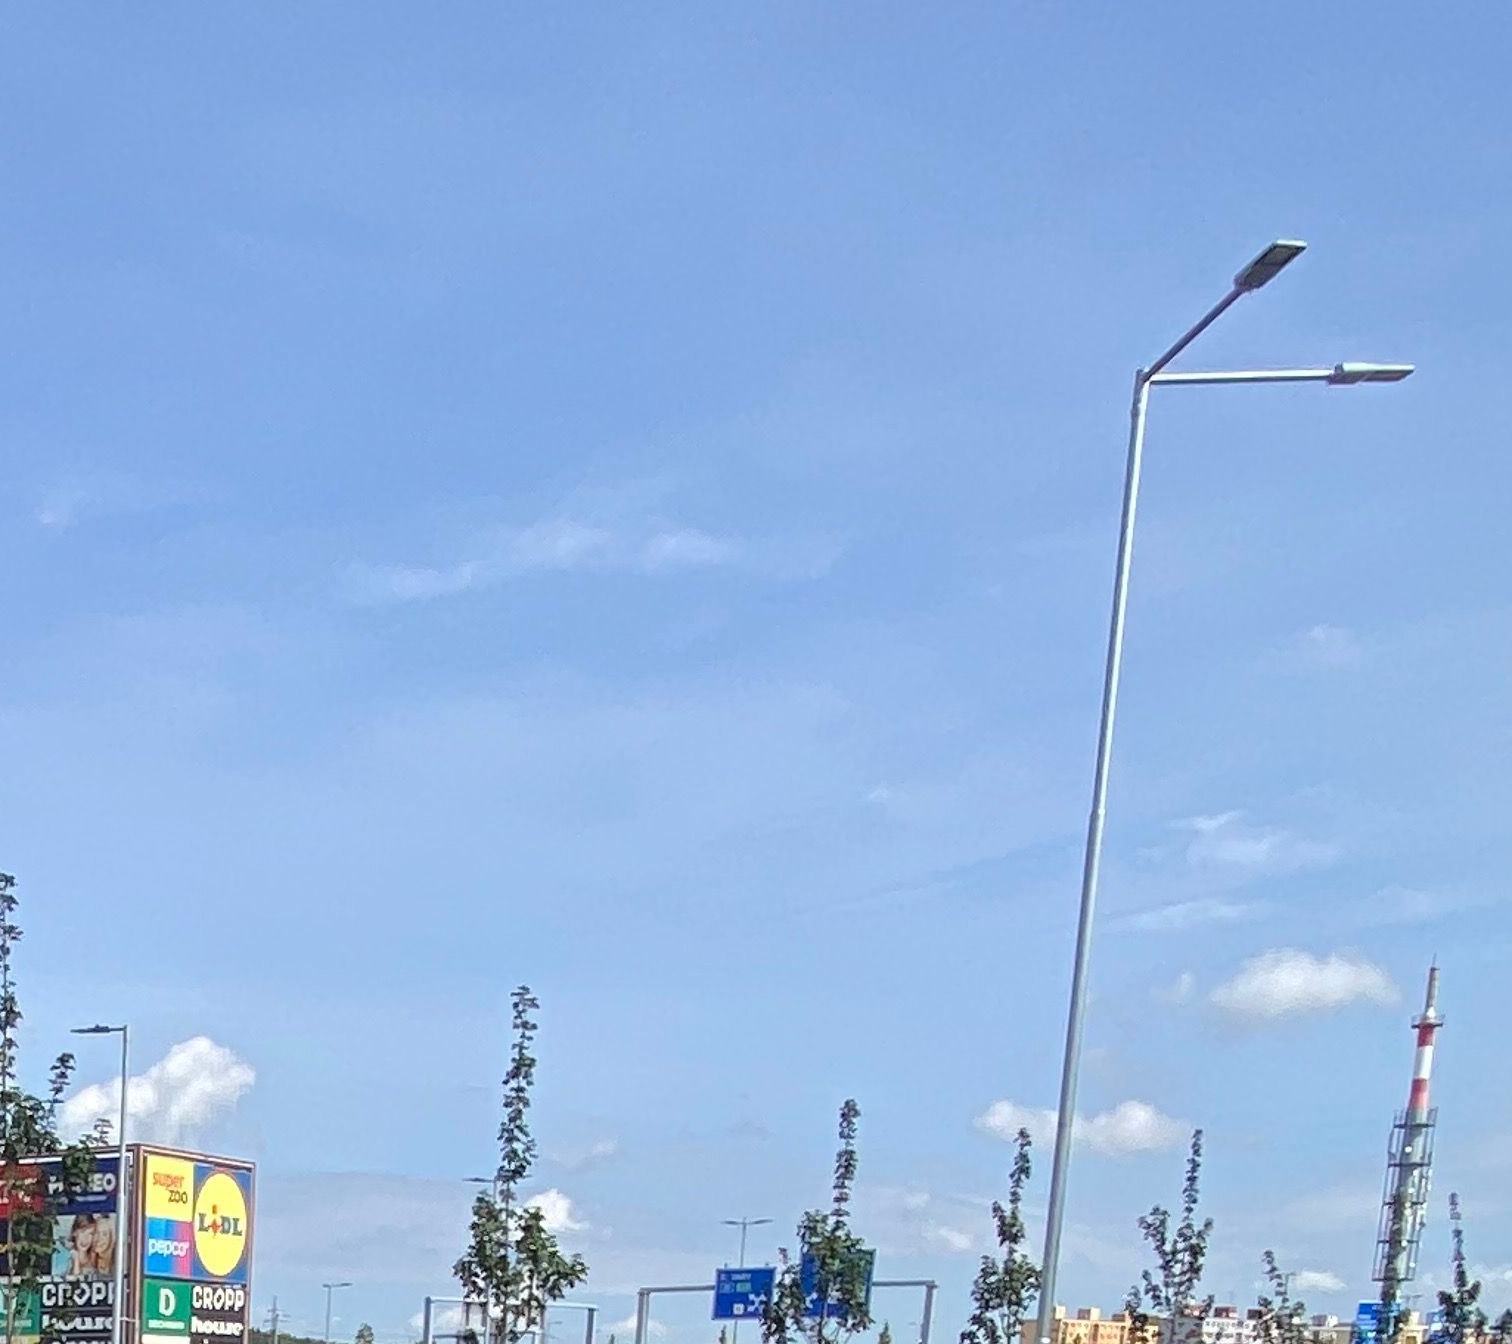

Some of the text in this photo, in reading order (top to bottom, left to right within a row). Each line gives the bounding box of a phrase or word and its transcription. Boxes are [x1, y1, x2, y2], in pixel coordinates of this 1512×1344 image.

[152, 1171, 185, 1192] super
[168, 1189, 188, 1204] zoo
[148, 1238, 190, 1257] pepco
[158, 1287, 176, 1316] D
[191, 1285, 245, 1311] CROPP
